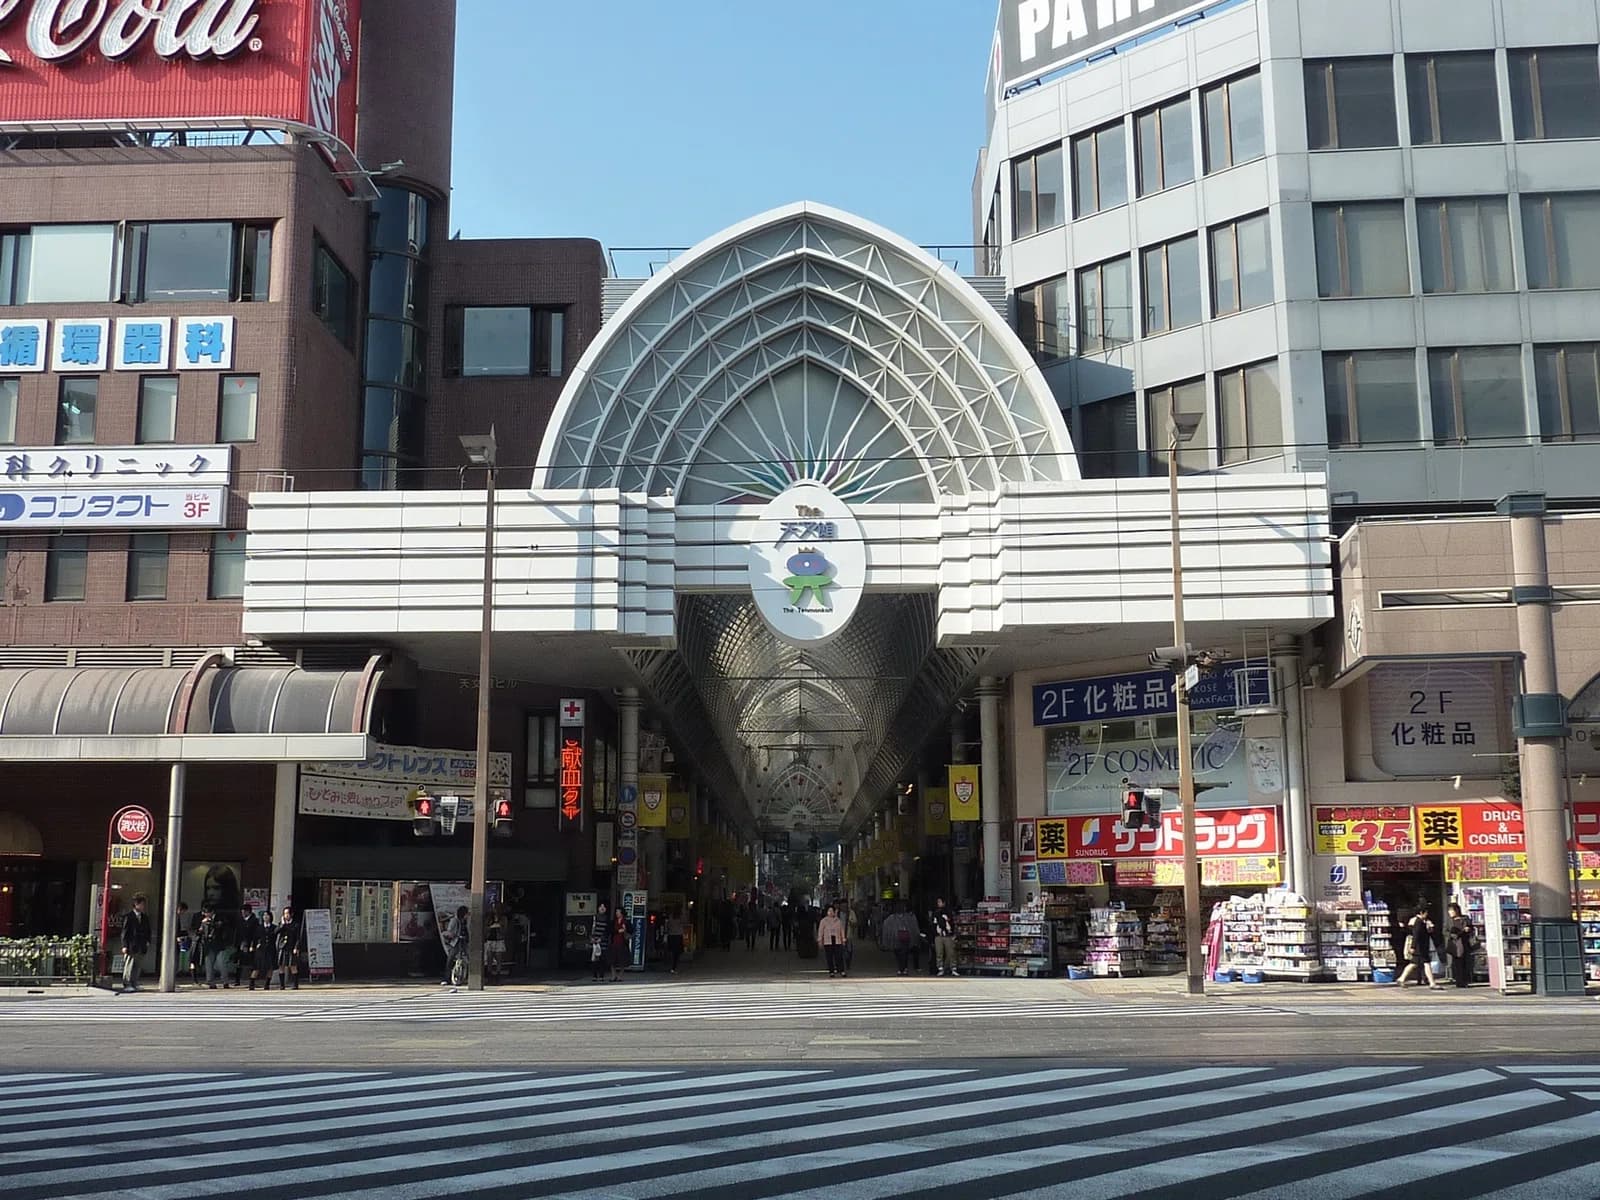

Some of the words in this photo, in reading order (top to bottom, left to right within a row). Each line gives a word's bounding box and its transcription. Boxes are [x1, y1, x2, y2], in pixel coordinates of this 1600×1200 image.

[1018, 0, 1156, 62] PA
[5, 454, 210, 481] 科クリニック
[29, 495, 170, 518] コンタクト
[183, 502, 210, 518] 3F
[1042, 688, 1075, 720] 2F
[1084, 678, 1169, 715] 化粧品
[1410, 690, 1452, 714] 2F
[1392, 722, 1476, 745] 化粧品
[1068, 753, 1095, 775] 2F
[120, 820, 147, 833] 消火栓
[1483, 810, 1520, 822] DRUG
[1498, 822, 1508, 833] &
[1040, 823, 1065, 854] 薬
[1423, 811, 1459, 846] 薬
[1075, 848, 1109, 857] SUNDRUG
[634, 896, 646, 904] 3F
